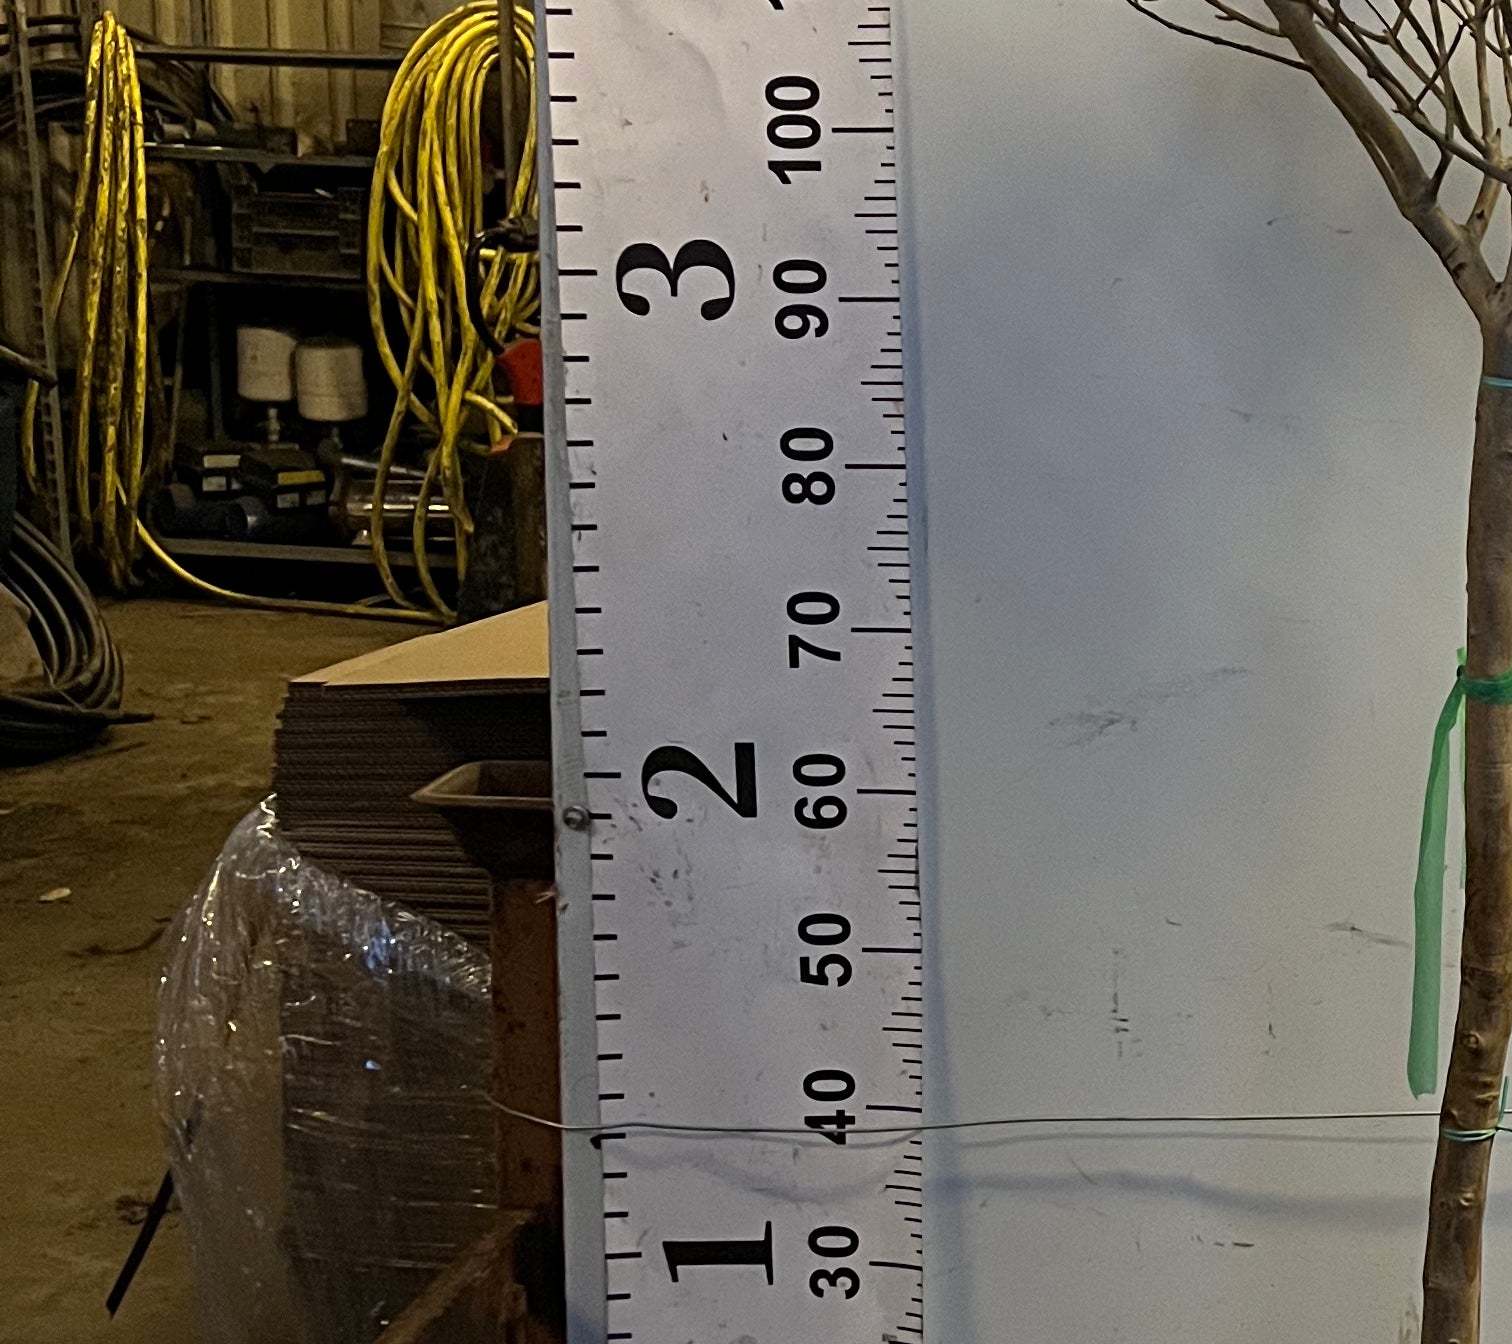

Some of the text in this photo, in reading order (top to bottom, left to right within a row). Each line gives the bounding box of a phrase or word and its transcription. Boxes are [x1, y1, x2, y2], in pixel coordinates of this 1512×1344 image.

[764, 75, 822, 185] 100
[615, 239, 736, 321] 3
[772, 259, 830, 340] 90
[779, 427, 836, 506] 80
[786, 591, 842, 669] 70
[640, 741, 758, 820] 2
[792, 753, 848, 830] 60
[797, 912, 853, 988] 50
[802, 1069, 856, 1146] 40
[661, 1220, 774, 1286] 1
[807, 1225, 861, 1300] 30
